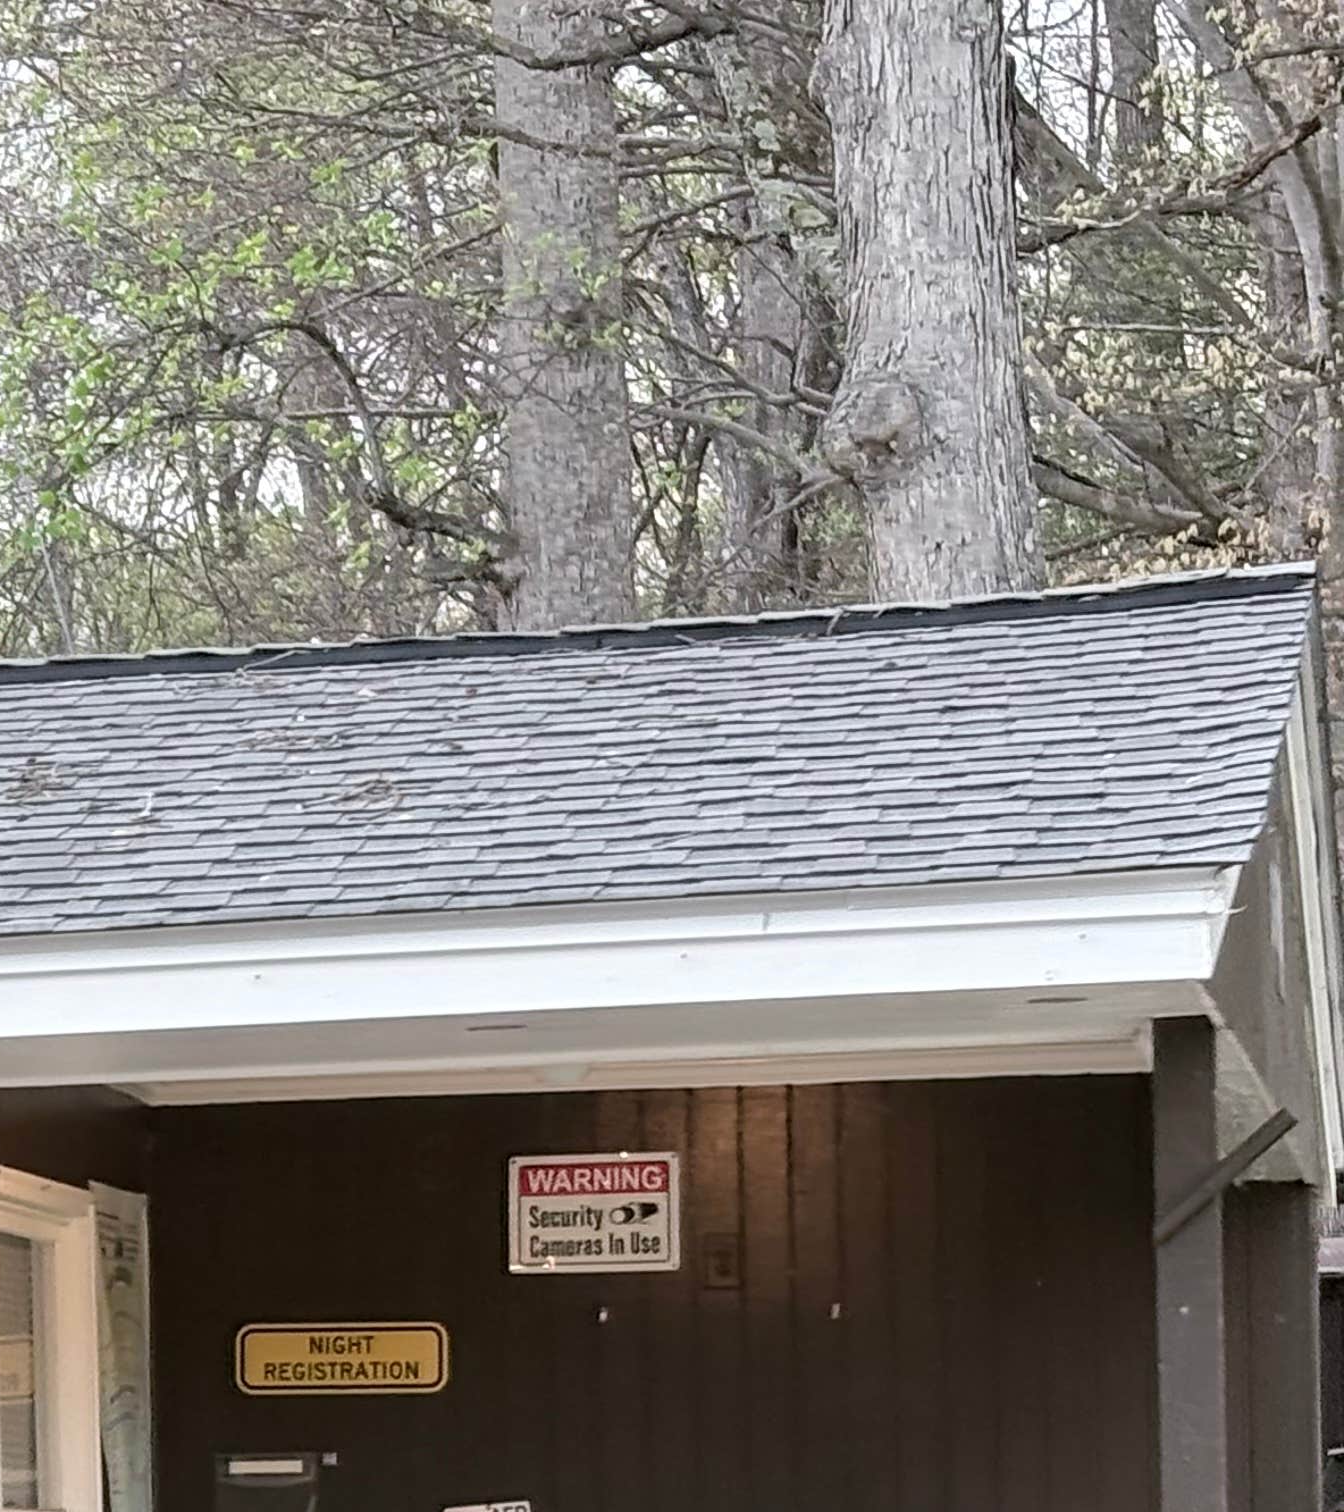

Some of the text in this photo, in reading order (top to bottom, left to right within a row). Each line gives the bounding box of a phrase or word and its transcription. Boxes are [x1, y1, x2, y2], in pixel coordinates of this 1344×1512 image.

[527, 1165, 663, 1193] WARNING
[529, 1204, 603, 1231] Security
[529, 1232, 660, 1258] Cameras In Use
[309, 1335, 374, 1355] NIGHT
[263, 1361, 420, 1381] REGISTRATION
